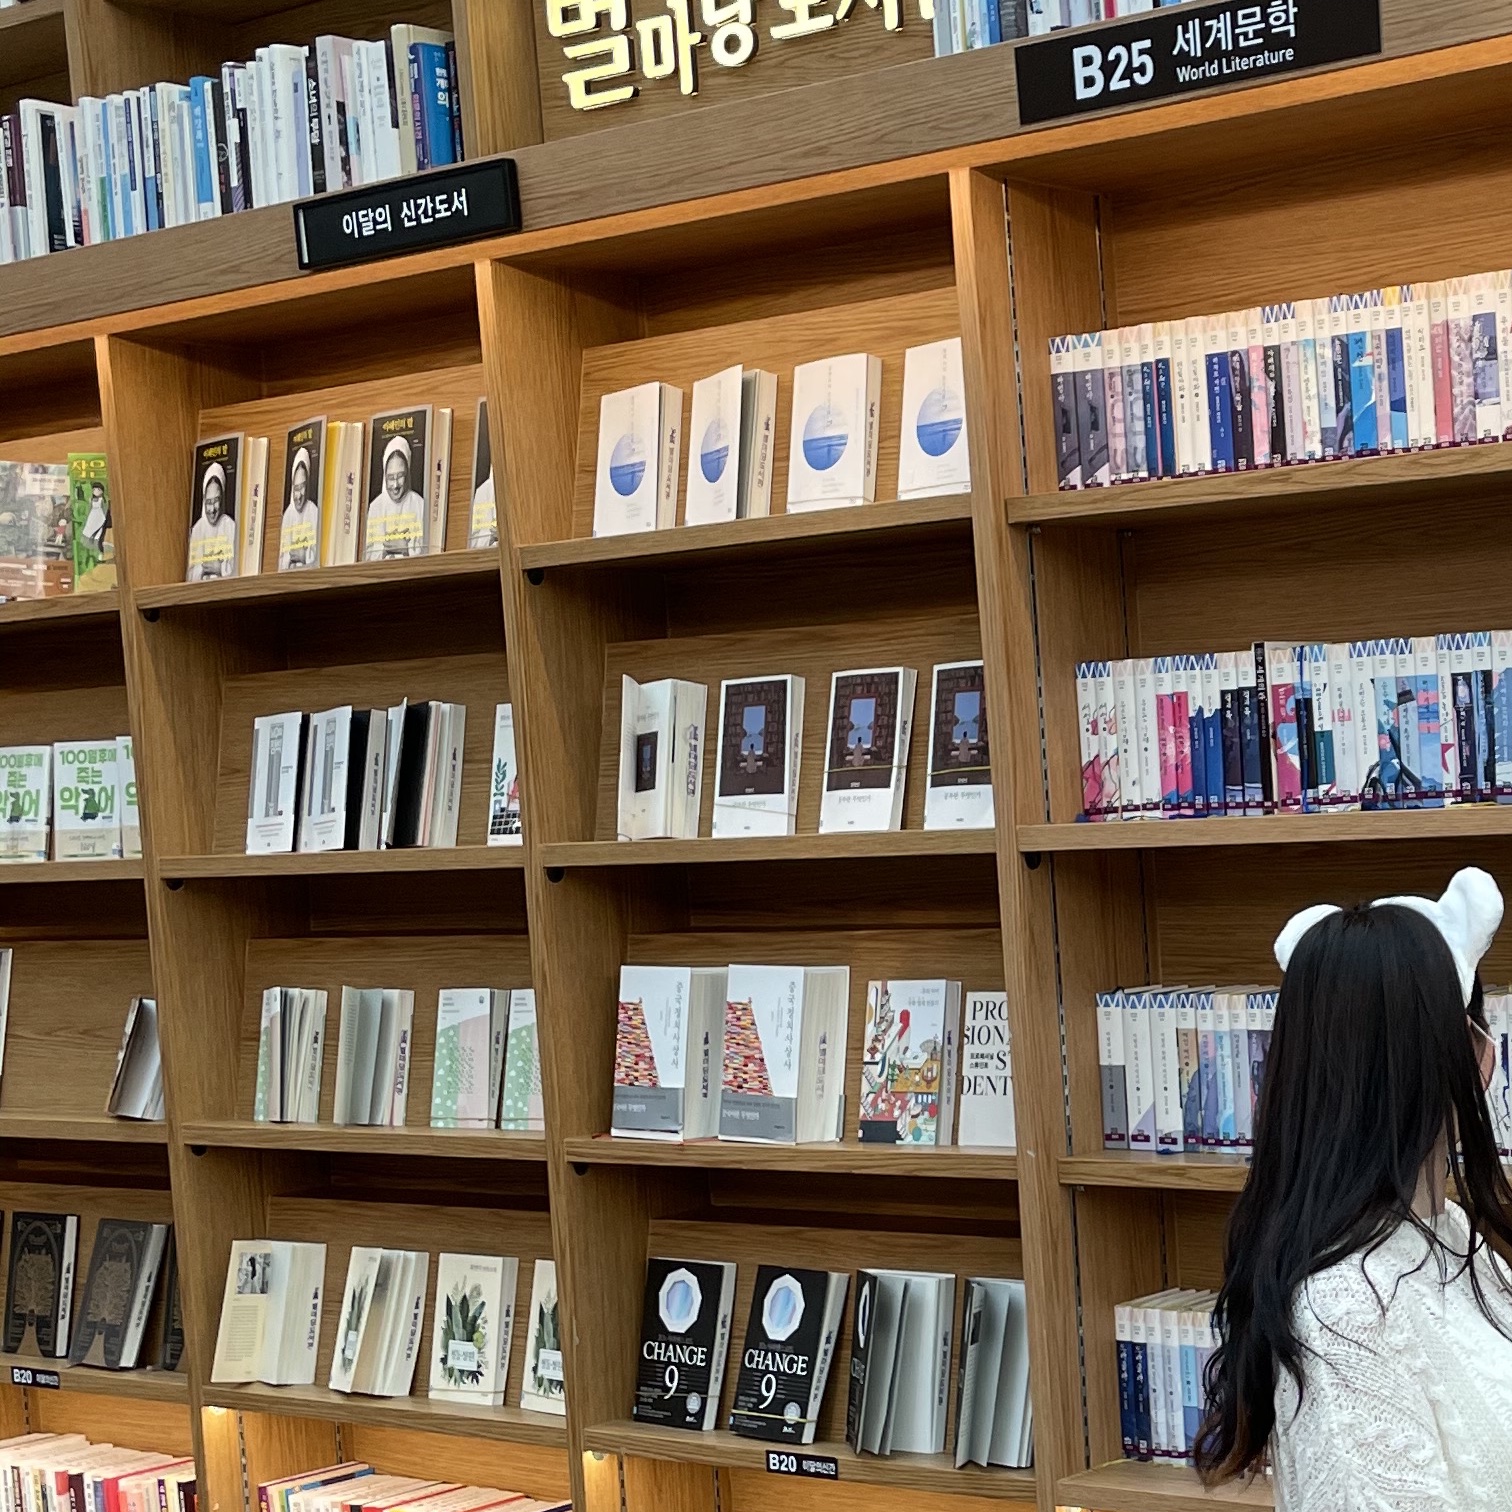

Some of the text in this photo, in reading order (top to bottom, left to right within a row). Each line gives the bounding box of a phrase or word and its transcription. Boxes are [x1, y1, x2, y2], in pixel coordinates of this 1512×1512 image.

[1172, 0, 1299, 58] 세계문학
[1072, 39, 1155, 101] B25
[1176, 46, 1295, 84] World Literature
[342, 187, 469, 239] 이달의 신간도서
[0, 753, 43, 769] 00일후에
[58, 747, 116, 766] 100일후에
[6, 770, 28, 789] 죽는
[76, 766, 103, 785] 죽는
[59, 785, 116, 816] 악어
[963, 1024, 1012, 1046] SION
[995, 1050, 1012, 1072] S
[643, 1340, 707, 1367] CHANGE
[744, 1348, 809, 1376] CHANGE
[13, 1367, 34, 1384] B20
[663, 1364, 680, 1400] 9
[758, 1373, 777, 1410] 9
[768, 1453, 797, 1473] B20
